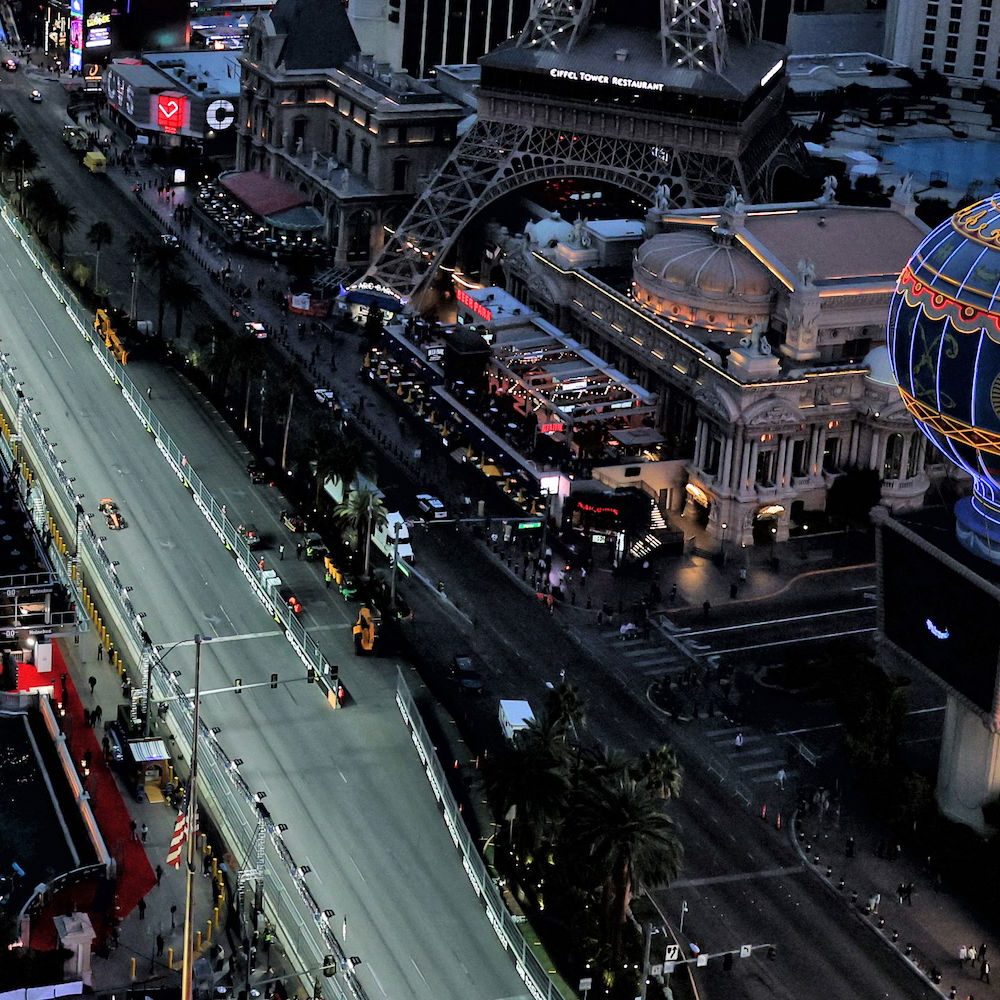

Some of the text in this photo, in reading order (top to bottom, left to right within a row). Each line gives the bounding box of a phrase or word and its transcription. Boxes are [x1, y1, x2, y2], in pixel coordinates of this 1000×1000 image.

[549, 68, 665, 92] EIFFEL TOWER RESTAURANT
[456, 289, 493, 321] BEER PARK
